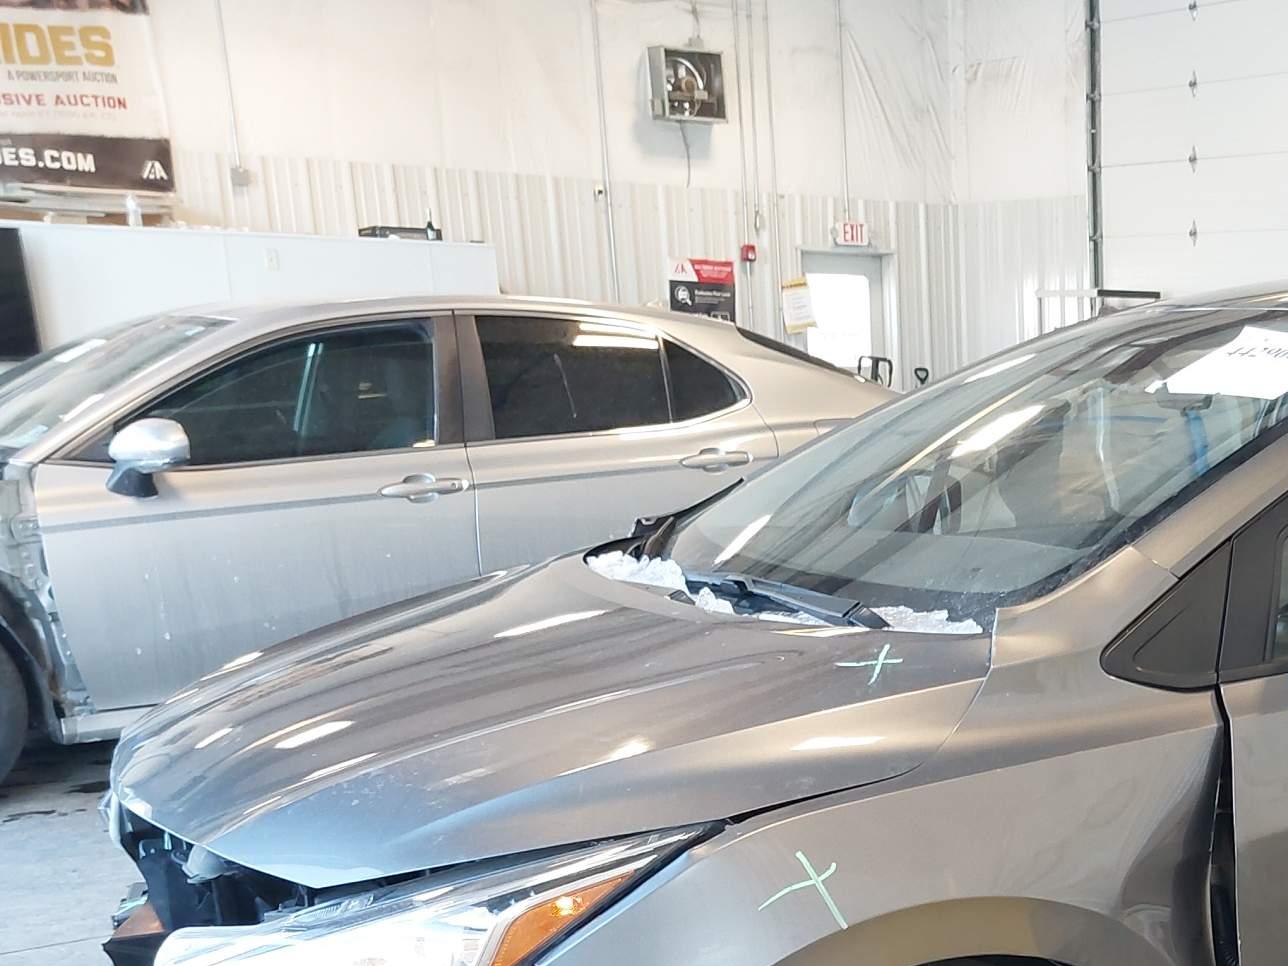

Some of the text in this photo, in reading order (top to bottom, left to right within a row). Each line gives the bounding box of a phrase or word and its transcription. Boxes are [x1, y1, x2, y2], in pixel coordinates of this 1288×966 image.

[82, 71, 118, 83] AUCTION
[0, 93, 127, 110] SIVE AUCTION
[0, 147, 96, 173] ES.COM
[843, 223, 864, 243] EXIT
